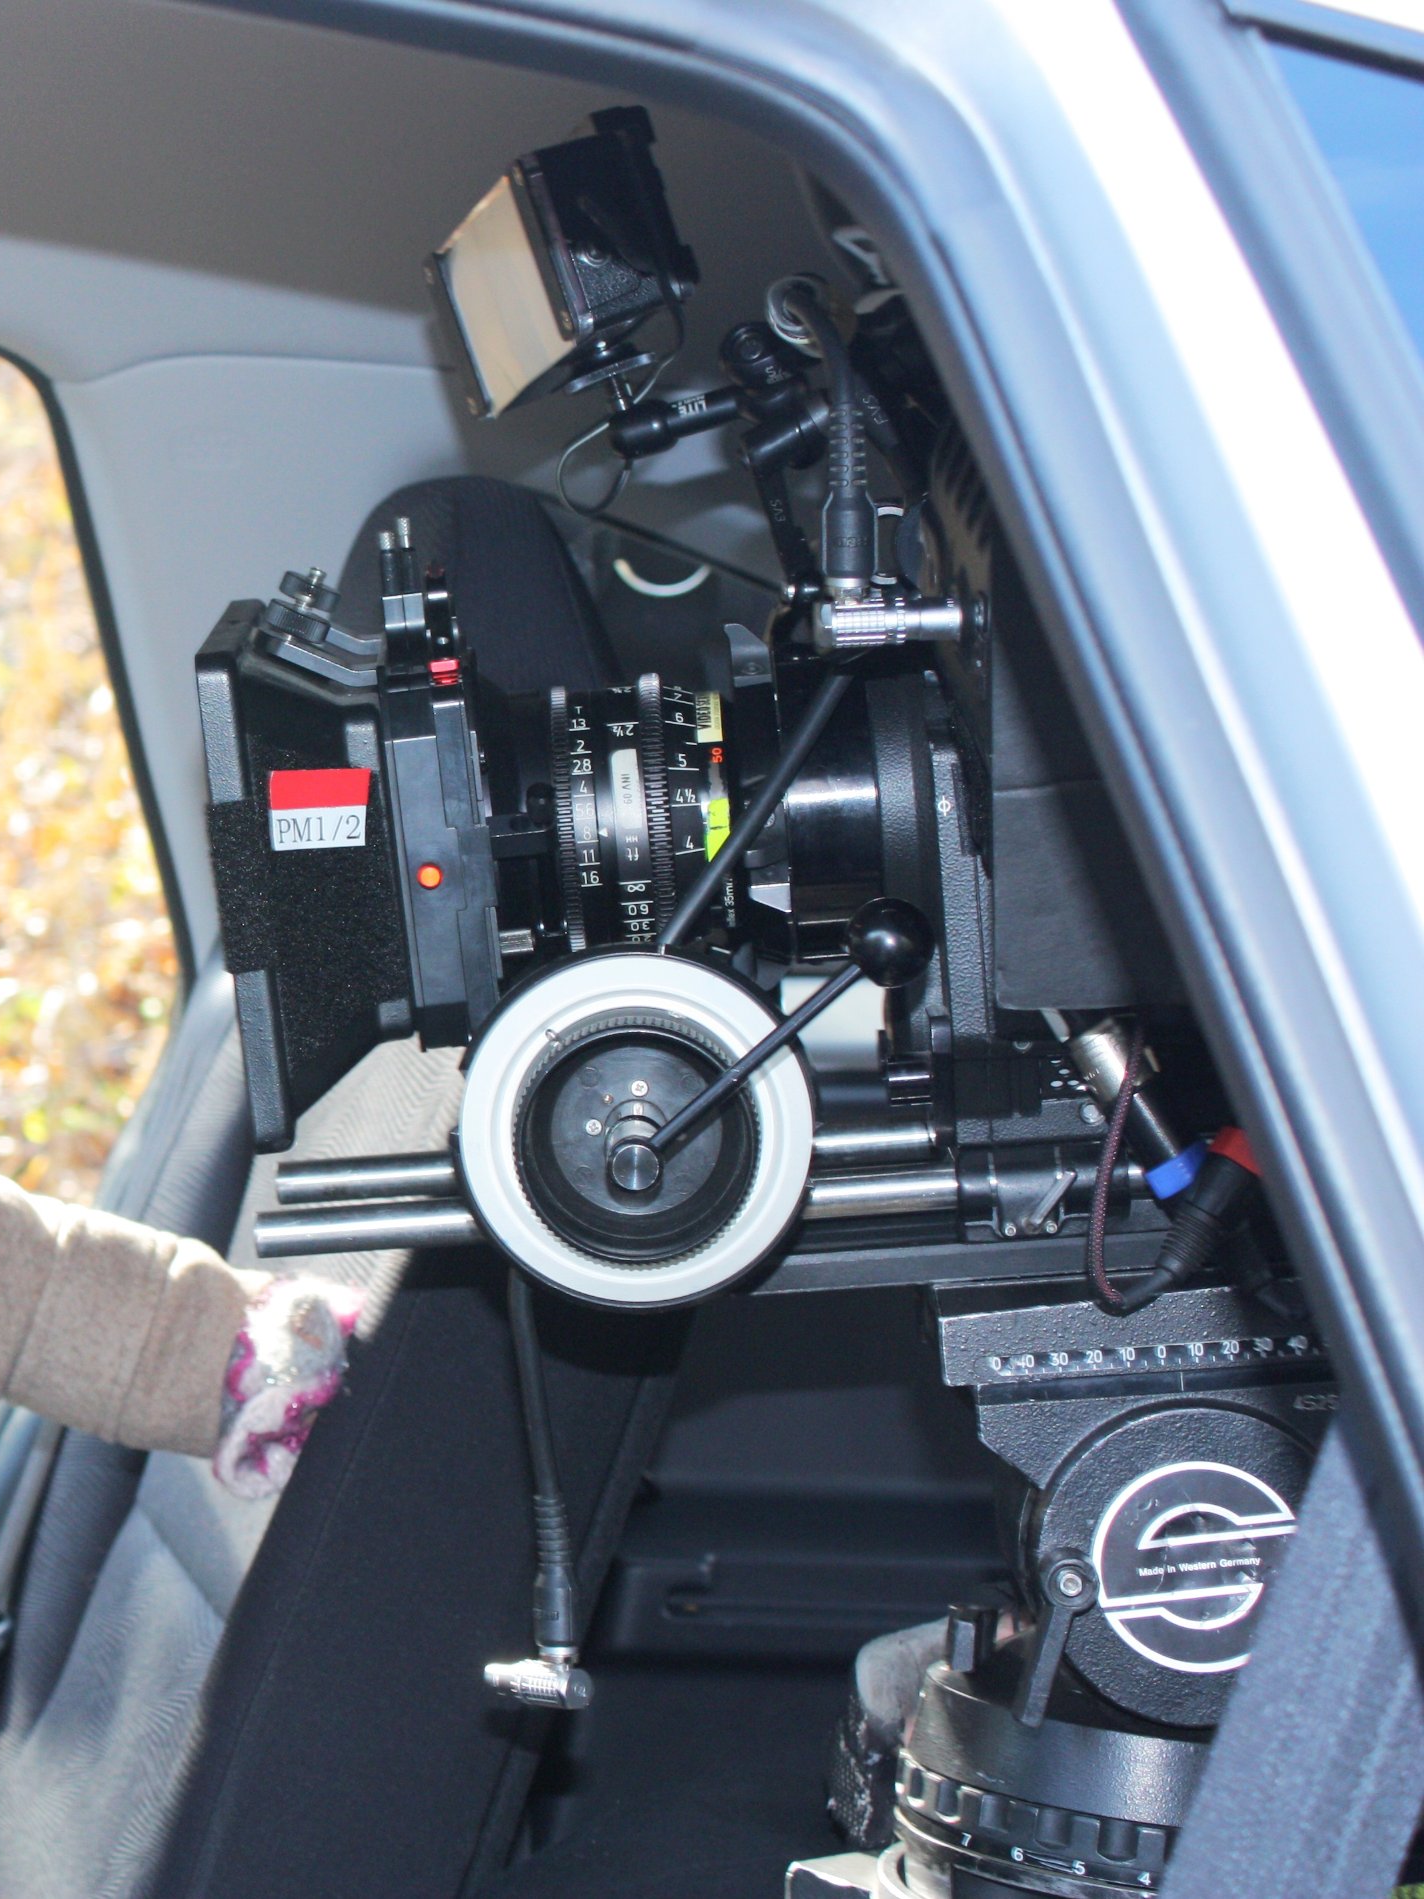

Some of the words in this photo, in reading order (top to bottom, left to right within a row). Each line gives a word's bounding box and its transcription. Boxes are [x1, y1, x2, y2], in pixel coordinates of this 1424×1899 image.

[576, 706, 583, 715] T
[675, 712, 684, 723] 6
[576, 740, 585, 752] 2
[678, 753, 687, 768] 5
[711, 747, 723, 763] 50
[580, 780, 588, 794] 4
[276, 814, 361, 844] PM1/2
[583, 826, 592, 841] 8
[686, 835, 694, 850] 4
[583, 849, 595, 863] 11
[581, 870, 599, 885] 16
[628, 903, 649, 916] 60
[630, 921, 651, 932] 30
[1050, 1352, 1069, 1366] 30
[1086, 1349, 1103, 1364] 20
[1119, 1347, 1135, 1361] 10
[1157, 1345, 1166, 1359] 0
[1188, 1342, 1204, 1356] 10
[1222, 1340, 1240, 1354] 20
[1138, 1566, 1164, 1577] Made
[1167, 1564, 1176, 1574] in
[1178, 1561, 1217, 1573] Western
[1219, 1557, 1260, 1568] Germany
[962, 1832, 972, 1847] 7
[1010, 1846, 1024, 1862] 6
[1073, 1860, 1086, 1875] 5
[1137, 1872, 1151, 1886] 4
